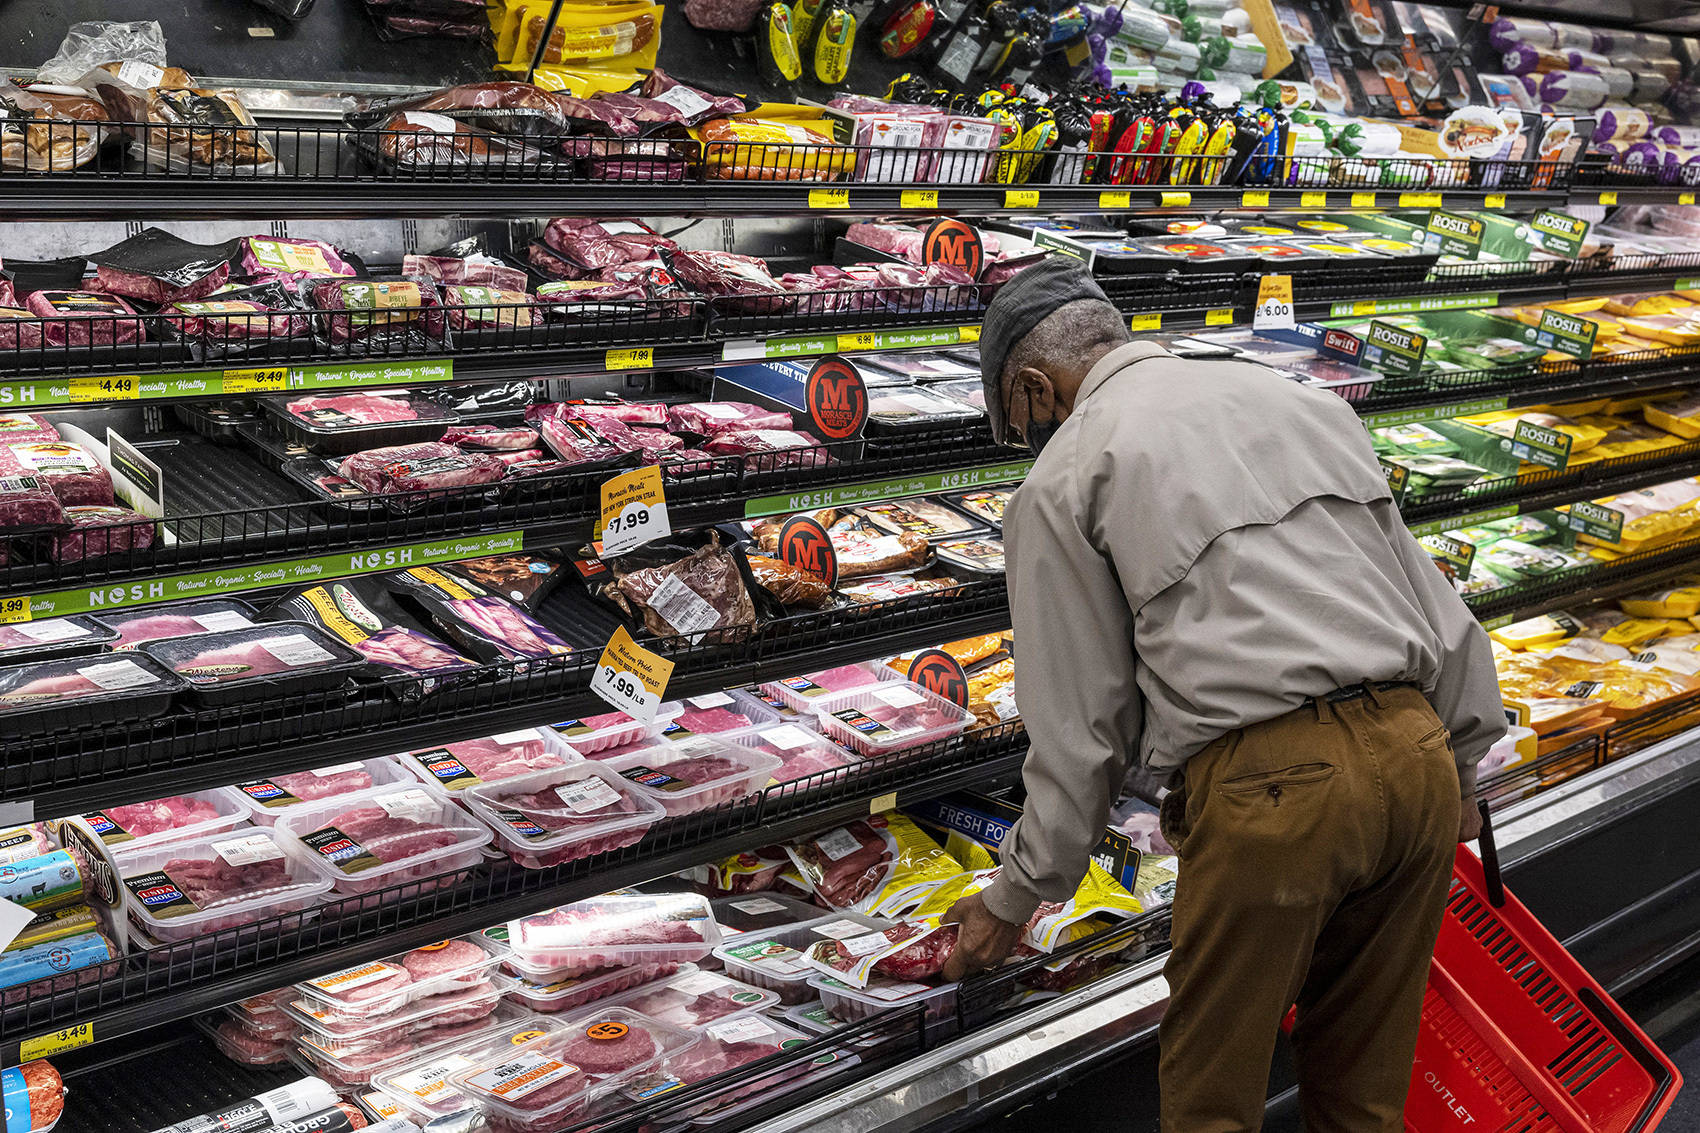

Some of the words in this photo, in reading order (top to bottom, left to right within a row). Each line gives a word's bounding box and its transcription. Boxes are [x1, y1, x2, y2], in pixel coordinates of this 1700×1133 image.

[1431, 214, 1470, 234] ROSIE
[1536, 213, 1573, 233] ROSIE
[1545, 314, 1582, 335] ROSIE
[1328, 333, 1356, 351] Swift
[1373, 326, 1412, 349] ROSIE
[630, 350, 649, 361] $7.99
[254, 371, 283, 384] $8.49
[315, 371, 343, 382] Natural
[350, 368, 377, 382] Organic
[383, 366, 413, 379] Specialty
[420, 364, 446, 377] Healthy
[769, 363, 793, 378] EVERY
[99, 378, 131, 393] $4.49
[139, 382, 168, 395] pecialty
[175, 379, 207, 391] Healthy
[820, 410, 853, 421] MORASCH
[1518, 425, 1557, 447] ROSIE
[940, 471, 980, 488] NOSH
[789, 491, 833, 509] NOSH
[1575, 502, 1609, 522] ROSIE
[609, 509, 650, 534] $7.99
[1422, 535, 1460, 555] ROSIE
[351, 548, 413, 571] NOSH
[423, 547, 449, 558] Natural
[455, 542, 481, 556] Organic
[486, 537, 515, 551] Specialty
[89, 581, 164, 607] NOSH
[176, 577, 207, 592] Natural
[215, 573, 245, 588] Organic
[253, 567, 286, 583] Specialty
[294, 563, 323, 577] Healthy
[316, 590, 338, 613] BEEF
[335, 615, 354, 628] TRI
[350, 626, 367, 639] TIP
[618, 643, 637, 664] Western
[637, 658, 653, 674] Pride
[186, 665, 240, 677] Western
[645, 675, 661, 689] ROAST
[430, 760, 460, 773] USDA
[434, 766, 467, 778] CHOICE
[247, 784, 274, 795] USDA
[251, 788, 285, 799] CHOICE
[939, 807, 982, 833] FRESH
[984, 822, 1009, 844] PO
[1, 836, 25, 848] BEEF
[306, 831, 340, 845] Premium
[324, 841, 352, 854] USDA
[328, 846, 363, 861] CHOICE
[126, 874, 166, 888] Premium
[142, 885, 175, 898] USDA
[144, 891, 182, 905] CHOICE
[56, 1024, 88, 1042] $3.49
[592, 1023, 623, 1038] $5
[494, 1077, 521, 1093] BEEF
[1425, 1072, 1476, 1124] OUTLET
